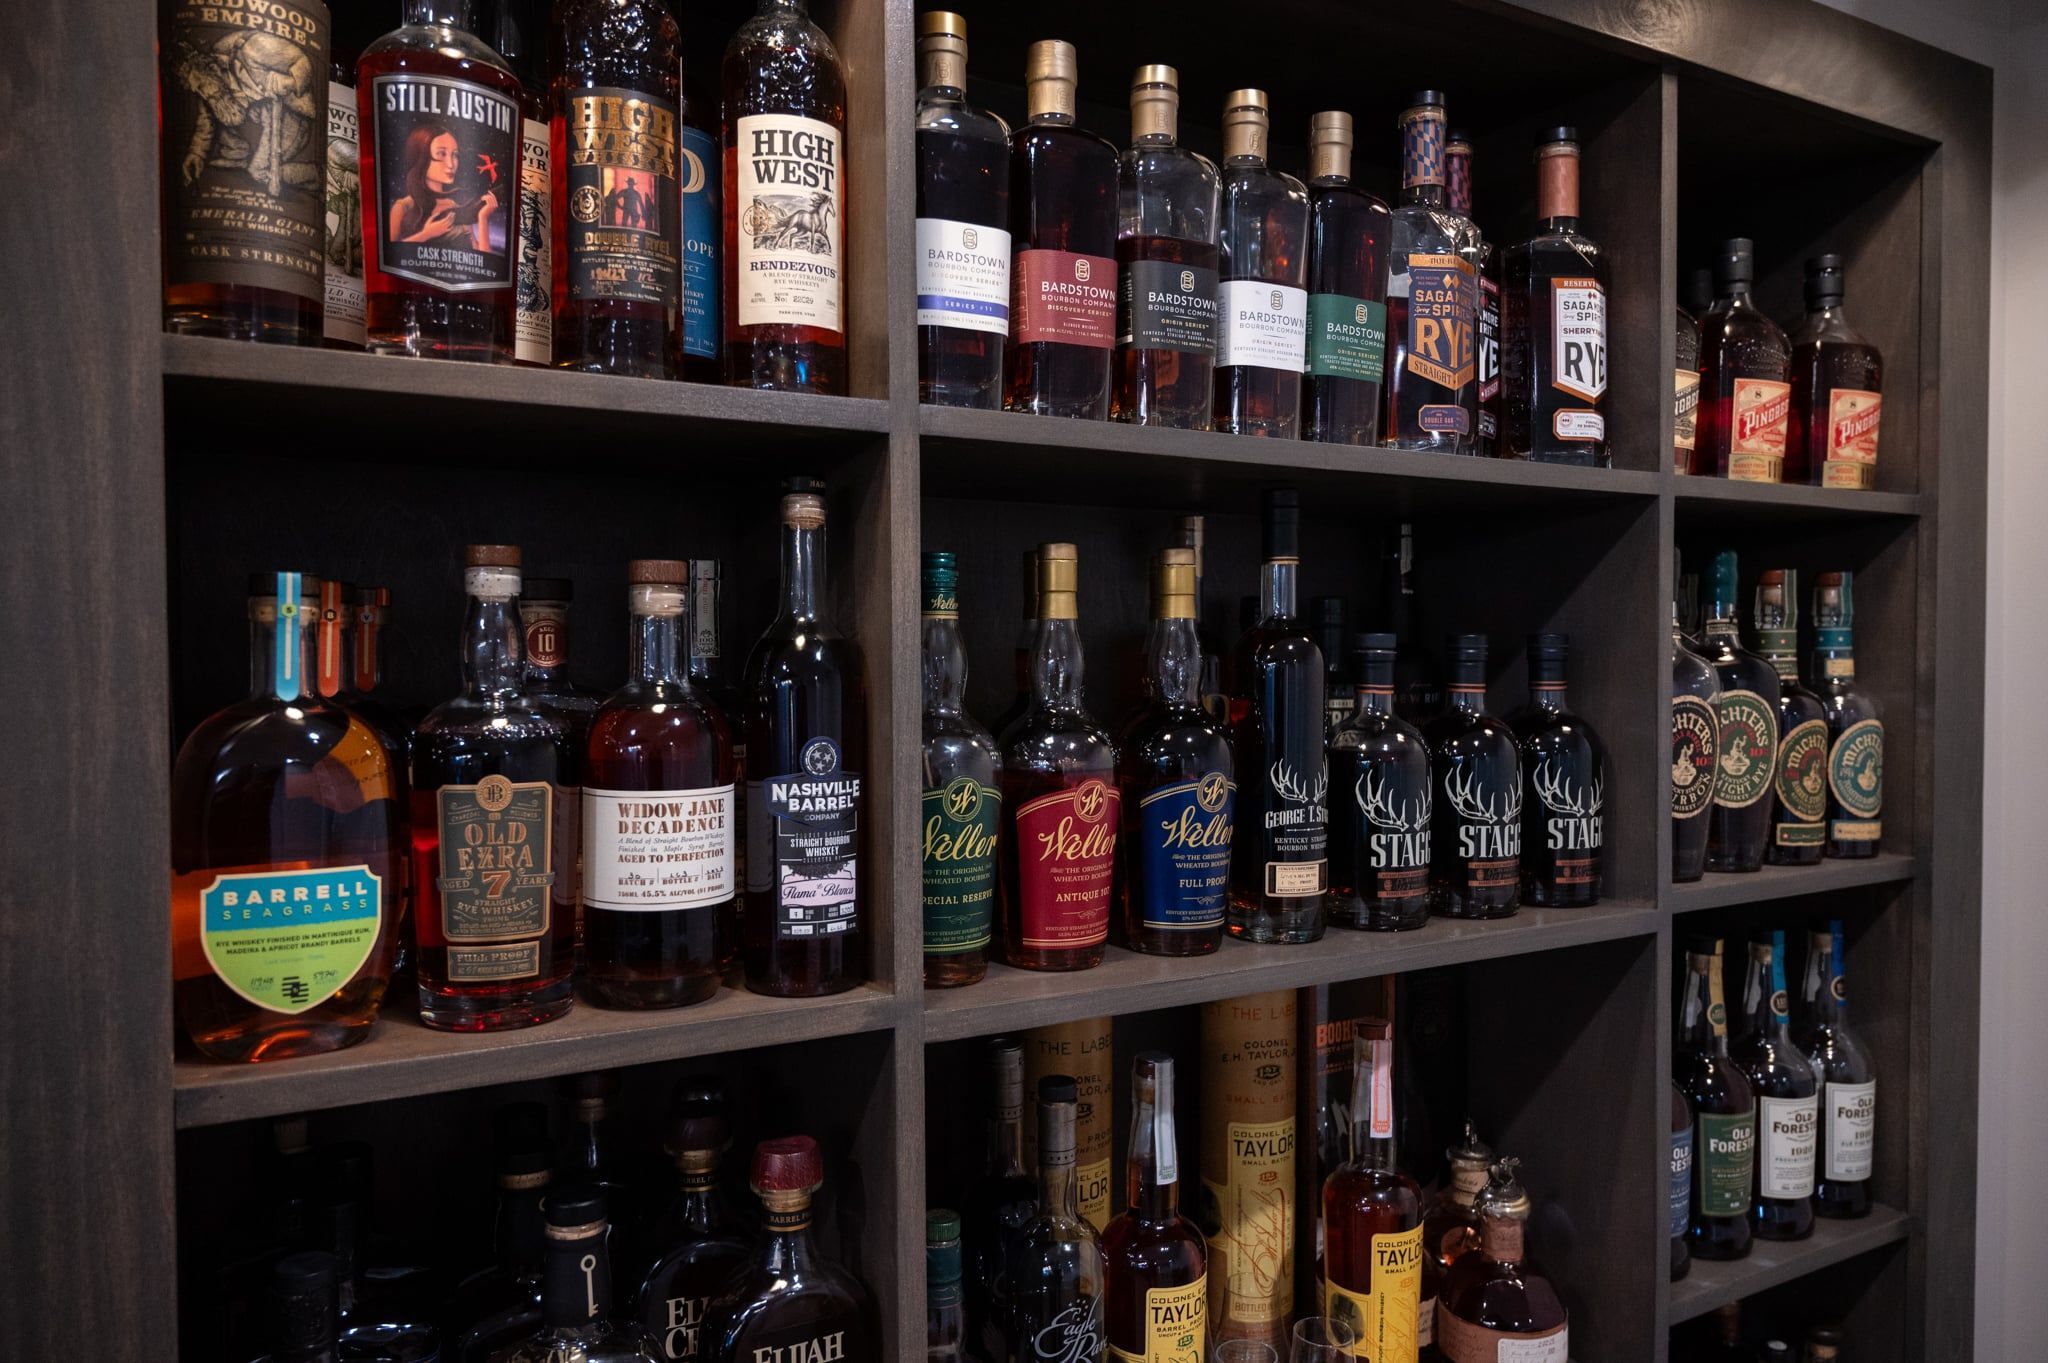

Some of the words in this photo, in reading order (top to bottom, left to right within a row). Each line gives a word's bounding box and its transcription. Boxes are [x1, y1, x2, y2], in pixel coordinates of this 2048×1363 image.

[200, 8, 307, 46] EMPIRE
[386, 83, 440, 113] STILL
[446, 88, 510, 133] AUSTIN
[571, 96, 674, 144] HIGH
[572, 129, 674, 163] WEST
[752, 129, 834, 168] HIGH
[752, 159, 834, 193] WEST
[247, 221, 292, 237] WHISKEY
[191, 246, 231, 257] CASK
[240, 248, 319, 275] STRENGTH
[417, 246, 439, 259] CASK
[441, 248, 484, 267] STRENGTH
[928, 248, 1005, 270] BARDSTOWN
[399, 258, 451, 269] BOURBON
[454, 263, 497, 278] WHISKEY
[750, 261, 837, 279] RENDEZVOUS
[928, 261, 967, 273] BOURBON
[970, 268, 1006, 279] COMPANY
[769, 271, 791, 279] BLEND
[799, 273, 828, 284] STRAIGHT
[1041, 281, 1116, 303] BARDSTOWN
[944, 300, 975, 311] SERIES
[1040, 294, 1080, 305] BOURBON
[1083, 299, 1116, 310] COMPANY
[1047, 304, 1085, 315] DISCOVERY
[1148, 291, 1217, 312] BARDSTOWN
[1147, 303, 1185, 315] BOURBON
[1187, 310, 1217, 320] COMPANY
[1239, 311, 1304, 329] BARDSTOWN
[1239, 322, 1275, 332] BOURBON
[1276, 327, 1304, 337] COMPANY
[1326, 334, 1359, 344] BOURBON
[1415, 317, 1473, 369] RYE
[1415, 360, 1452, 385] STRAIGHT
[1564, 341, 1605, 389] RYE
[538, 633, 555, 653] 10
[771, 779, 860, 804] NASHVILLE
[617, 802, 684, 818] WIDOW
[688, 798, 725, 817] JANE
[788, 795, 854, 813] BARREL
[617, 815, 725, 835] DECADENCE
[804, 812, 841, 823] COMPANY
[1265, 809, 1306, 830] GEORGE
[1308, 805, 1316, 823] T.
[464, 821, 527, 846] OLD
[625, 837, 643, 845] Blend
[644, 837, 652, 846] of
[654, 834, 678, 846] Straight
[680, 833, 704, 843] Bourbon
[790, 837, 823, 849] STRAIGHT
[824, 834, 851, 847] BOURBON
[1038, 815, 1117, 862] Weller
[1274, 836, 1309, 845] KENTUCKY
[617, 854, 646, 864] AGED
[649, 854, 663, 864] TO
[666, 847, 725, 863] PERFECTION
[618, 845, 646, 854] Finished
[663, 845, 684, 855] Maple
[688, 842, 705, 853] Syrup
[805, 846, 840, 858] WHISKEY
[1277, 844, 1309, 852] BOURBON
[457, 844, 534, 870] EZRA
[1188, 854, 1201, 862] THE
[1202, 852, 1226, 861] ORIGINAL
[935, 867, 952, 877] THE
[953, 864, 986, 875] ORIGINAL
[1065, 867, 1081, 876] THE
[1082, 862, 1108, 873] ORIGINAL
[1176, 861, 1209, 871] WHEATED
[442, 877, 470, 889] AGED
[481, 869, 511, 900] 7
[515, 874, 548, 886] YEARS
[618, 879, 646, 887] BATCH
[662, 876, 692, 886] BOTTLE
[707, 872, 721, 881] DATE
[1054, 872, 1089, 884] WHEATED
[1179, 878, 1203, 888] FULL
[1205, 876, 1227, 887] PROOF
[223, 881, 368, 907] BARRELL
[641, 889, 667, 898] 45.5%
[669, 888, 695, 897] ALC/VOL
[822, 881, 855, 897] Blanca
[962, 887, 993, 905] RESERVE
[1055, 888, 1099, 903] ANTIQUE
[456, 900, 478, 914] RYE
[480, 897, 534, 916] WHISKEY
[474, 896, 517, 906] STRAIGHT
[223, 898, 368, 921] SEAGRASS
[216, 938, 230, 948] RYE
[232, 936, 265, 947] WHISKEY
[266, 933, 300, 944] FINISHED
[302, 932, 310, 940] IN
[311, 927, 352, 939] MARTINIQUE
[226, 944, 259, 955] MADEIRA
[261, 943, 267, 952] &
[269, 940, 299, 952] APRICOT
[301, 938, 329, 949] BRANDY
[331, 935, 361, 946] BARRELS
[456, 952, 488, 963] FULL
[490, 947, 530, 961] PROOF
[1231, 1007, 1263, 1021] THE
[1040, 1041, 1072, 1056] THE
[1244, 1039, 1290, 1050] COLONEL
[1795, 1112, 1813, 1123] OLD
[1234, 1130, 1278, 1139] COLONEL
[1731, 1128, 1750, 1142] OLD
[1234, 1132, 1295, 1157] TAYLOR
[769, 1213, 801, 1225] BARREL
[1376, 1238, 1415, 1248] COLONEL
[1385, 1265, 1406, 1275] SMALL
[1151, 1292, 1197, 1304] COLONEL
[1156, 1324, 1187, 1333] BARREL
